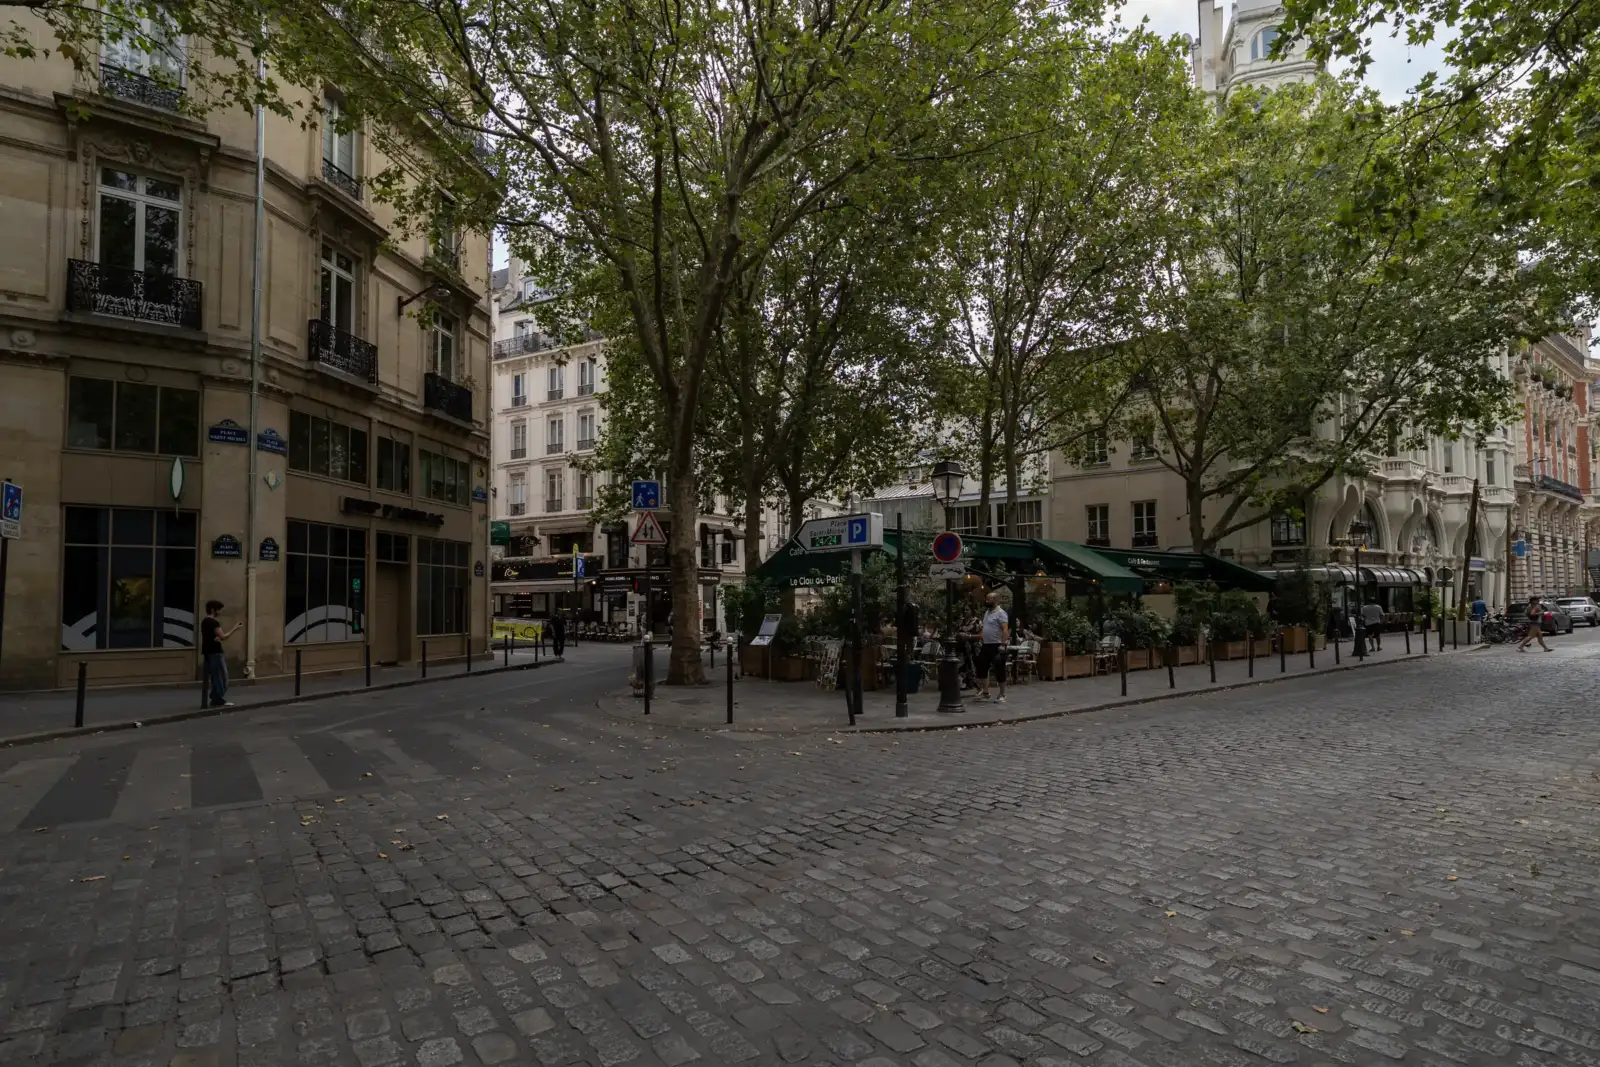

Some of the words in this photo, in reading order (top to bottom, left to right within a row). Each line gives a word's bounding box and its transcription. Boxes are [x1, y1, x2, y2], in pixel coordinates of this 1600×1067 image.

[852, 523, 862, 539] P
[577, 559, 583, 573] P
[790, 578, 798, 586] Le
[799, 576, 814, 586] Clou
[826, 574, 848, 584] Paris
